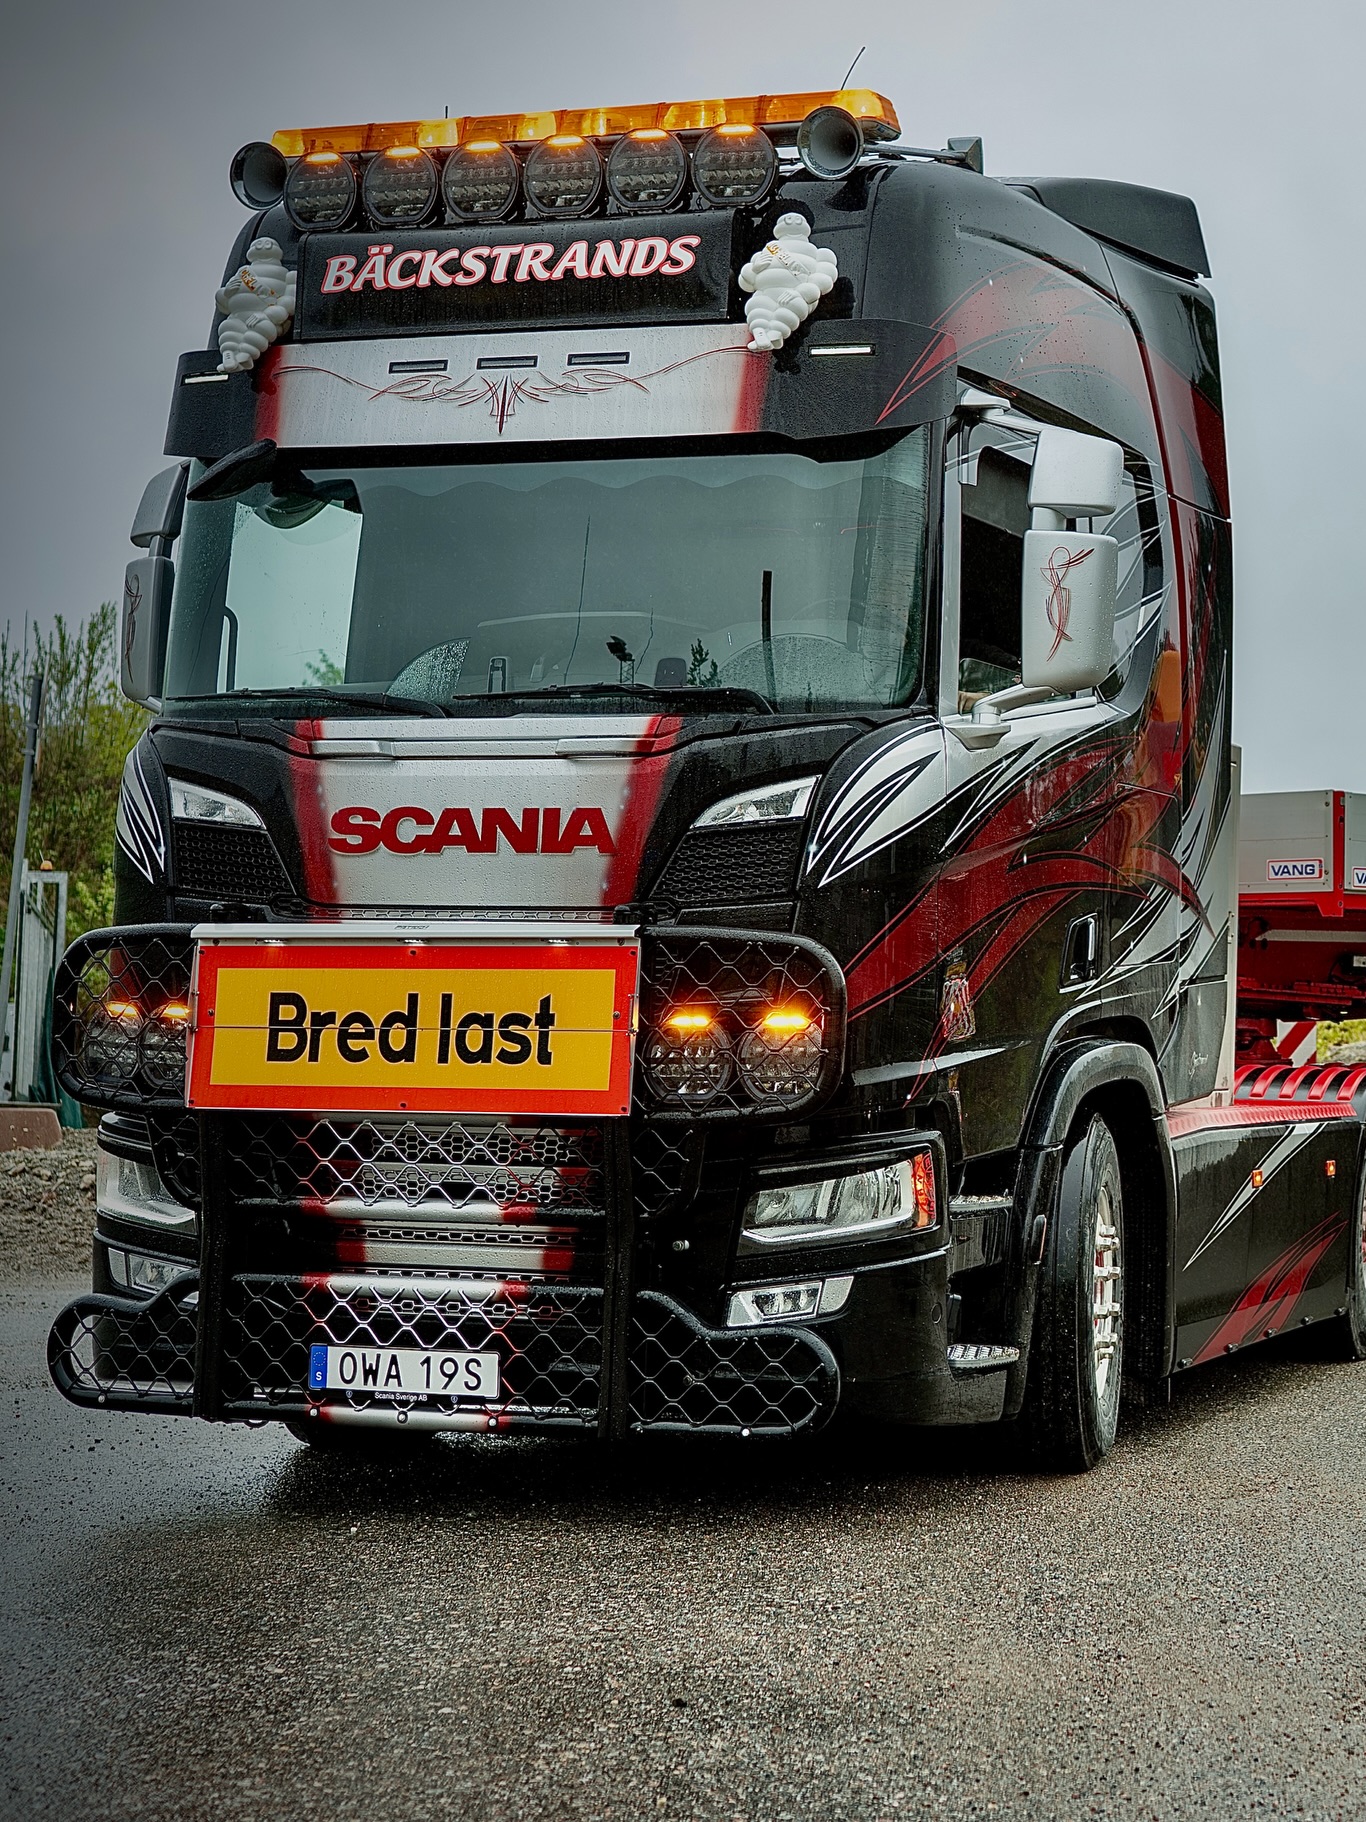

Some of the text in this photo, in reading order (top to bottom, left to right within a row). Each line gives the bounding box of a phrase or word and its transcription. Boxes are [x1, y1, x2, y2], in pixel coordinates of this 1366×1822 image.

[320, 235, 702, 294] BÄCKSTRANDS
[328, 806, 618, 855] SCANIA
[1270, 863, 1316, 877] VANG
[265, 991, 556, 1065] Bred last
[315, 1371, 323, 1381] S
[339, 1351, 482, 1392] OWA 19S
[374, 1391, 428, 1403] Scania Sverige AB
